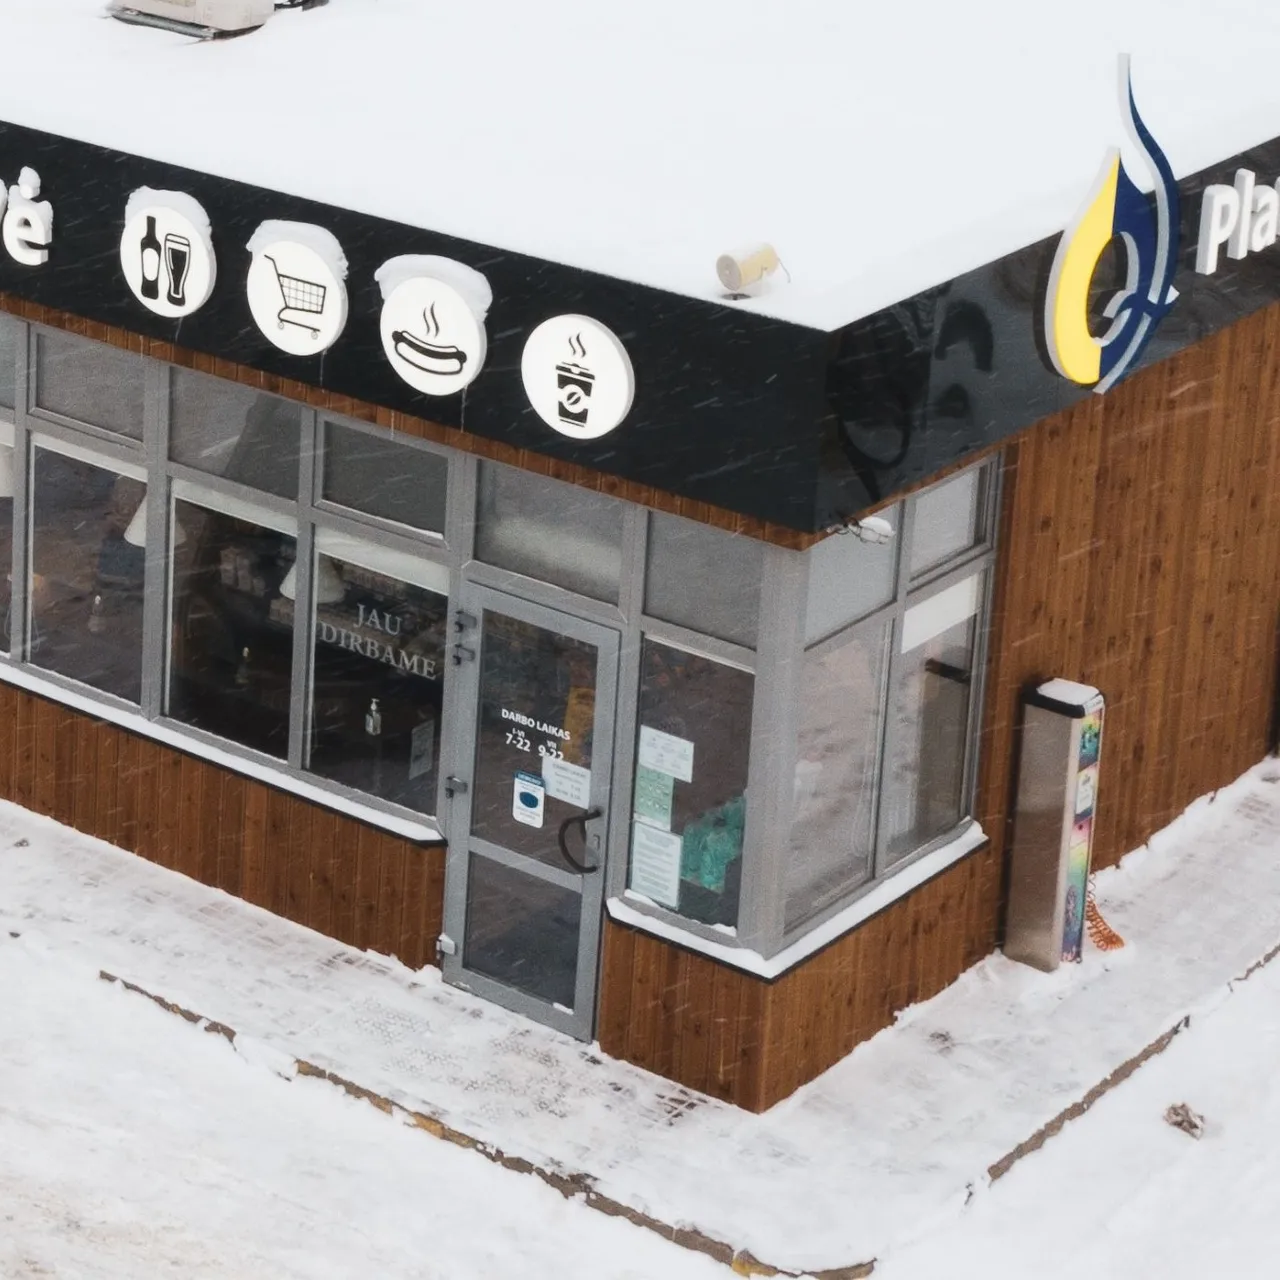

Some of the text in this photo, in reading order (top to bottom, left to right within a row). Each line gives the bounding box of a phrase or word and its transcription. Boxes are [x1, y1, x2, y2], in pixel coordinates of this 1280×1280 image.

[1195, 168, 1280, 275] Pla
[354, 603, 402, 636] JAU
[318, 622, 437, 681] DIRBAME
[501, 708, 571, 740] DARBO LAIKAS
[505, 733, 530, 752] 7-22
[538, 744, 564, 760] 9-22
